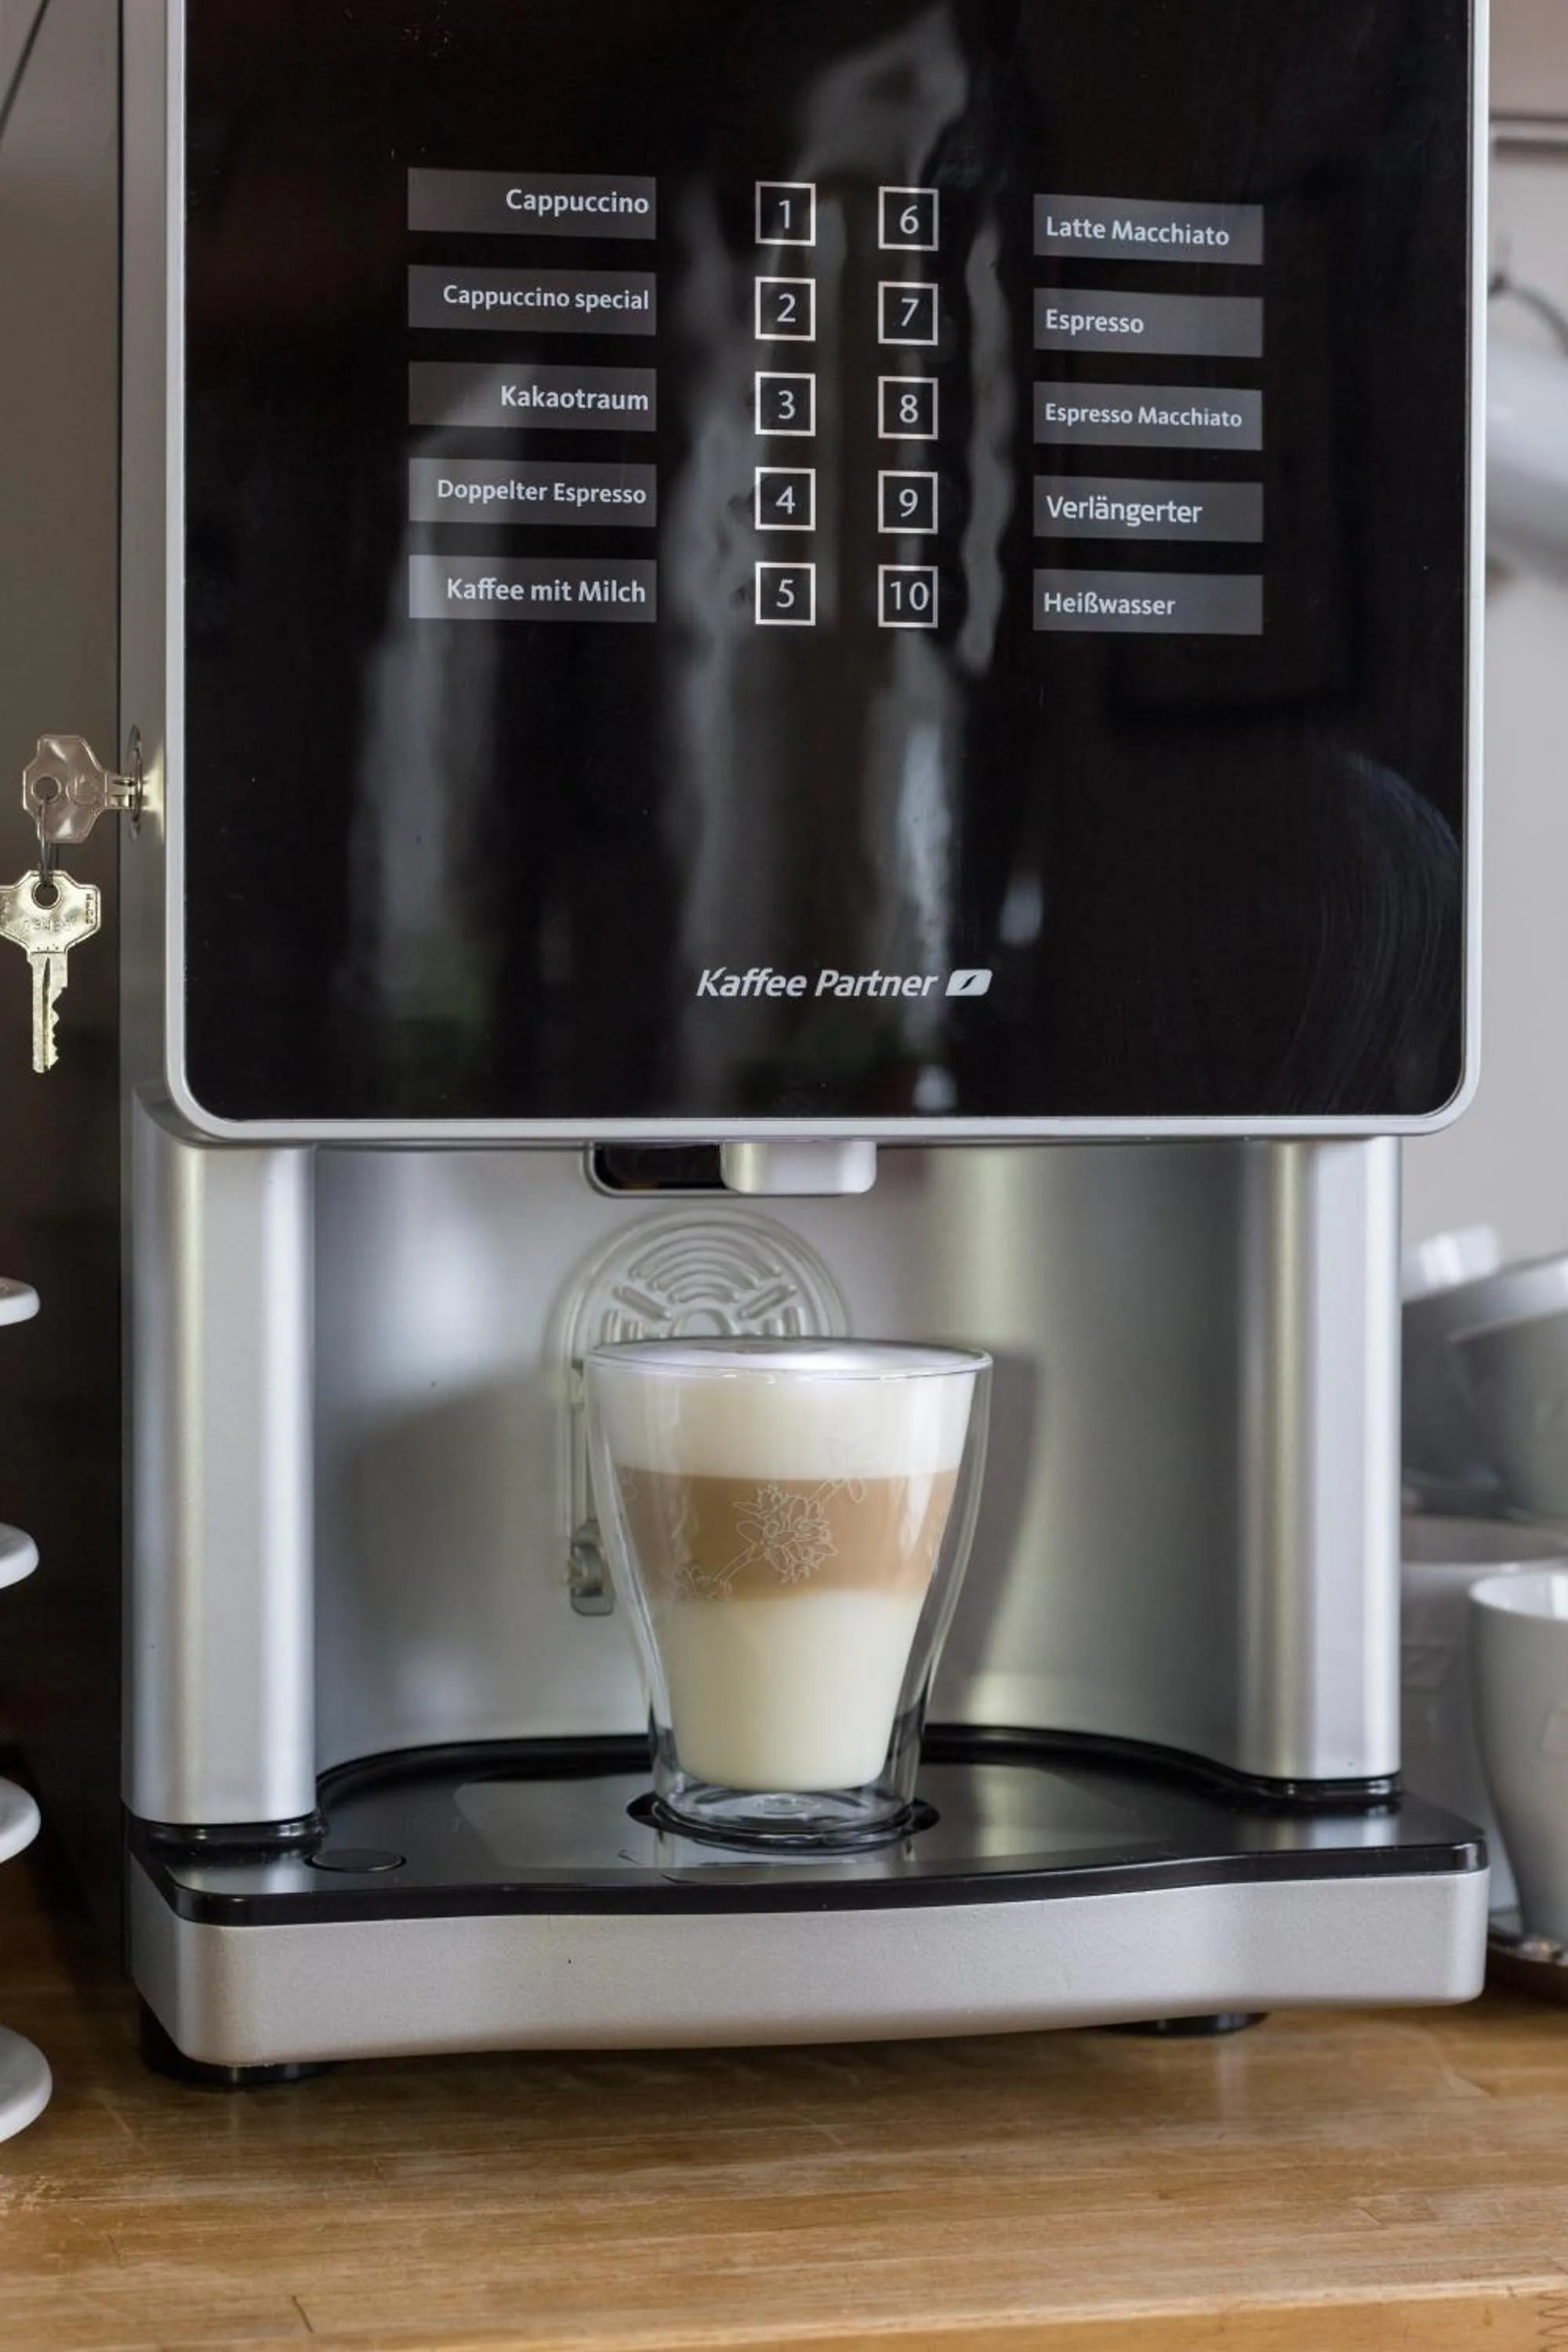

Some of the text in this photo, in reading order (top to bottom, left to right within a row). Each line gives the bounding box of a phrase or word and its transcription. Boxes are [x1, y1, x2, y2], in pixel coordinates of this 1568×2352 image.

[506, 188, 649, 217] Cappuccino
[778, 200, 791, 229] 1
[899, 205, 919, 234] 6
[1047, 216, 1229, 245] Latte Macchiato
[443, 285, 648, 313] Cappuccino special
[777, 293, 796, 322] 2
[901, 297, 920, 327] 7
[1047, 309, 1144, 336] Espresso
[501, 385, 648, 411] Kakaotraum
[778, 390, 796, 419] 3
[899, 394, 919, 424] 8
[1046, 403, 1243, 427] Espresso Macchiato
[437, 479, 647, 507] Doppelter Espresso
[775, 485, 796, 514] 4
[899, 488, 918, 517] 9
[1047, 495, 1203, 527] Verlängerter
[448, 577, 645, 603] Kaffee mit Milch
[776, 579, 794, 608] 5
[890, 581, 929, 611] 10
[1044, 591, 1176, 615] Heißwasser
[696, 967, 938, 996] Kaffee Partner
